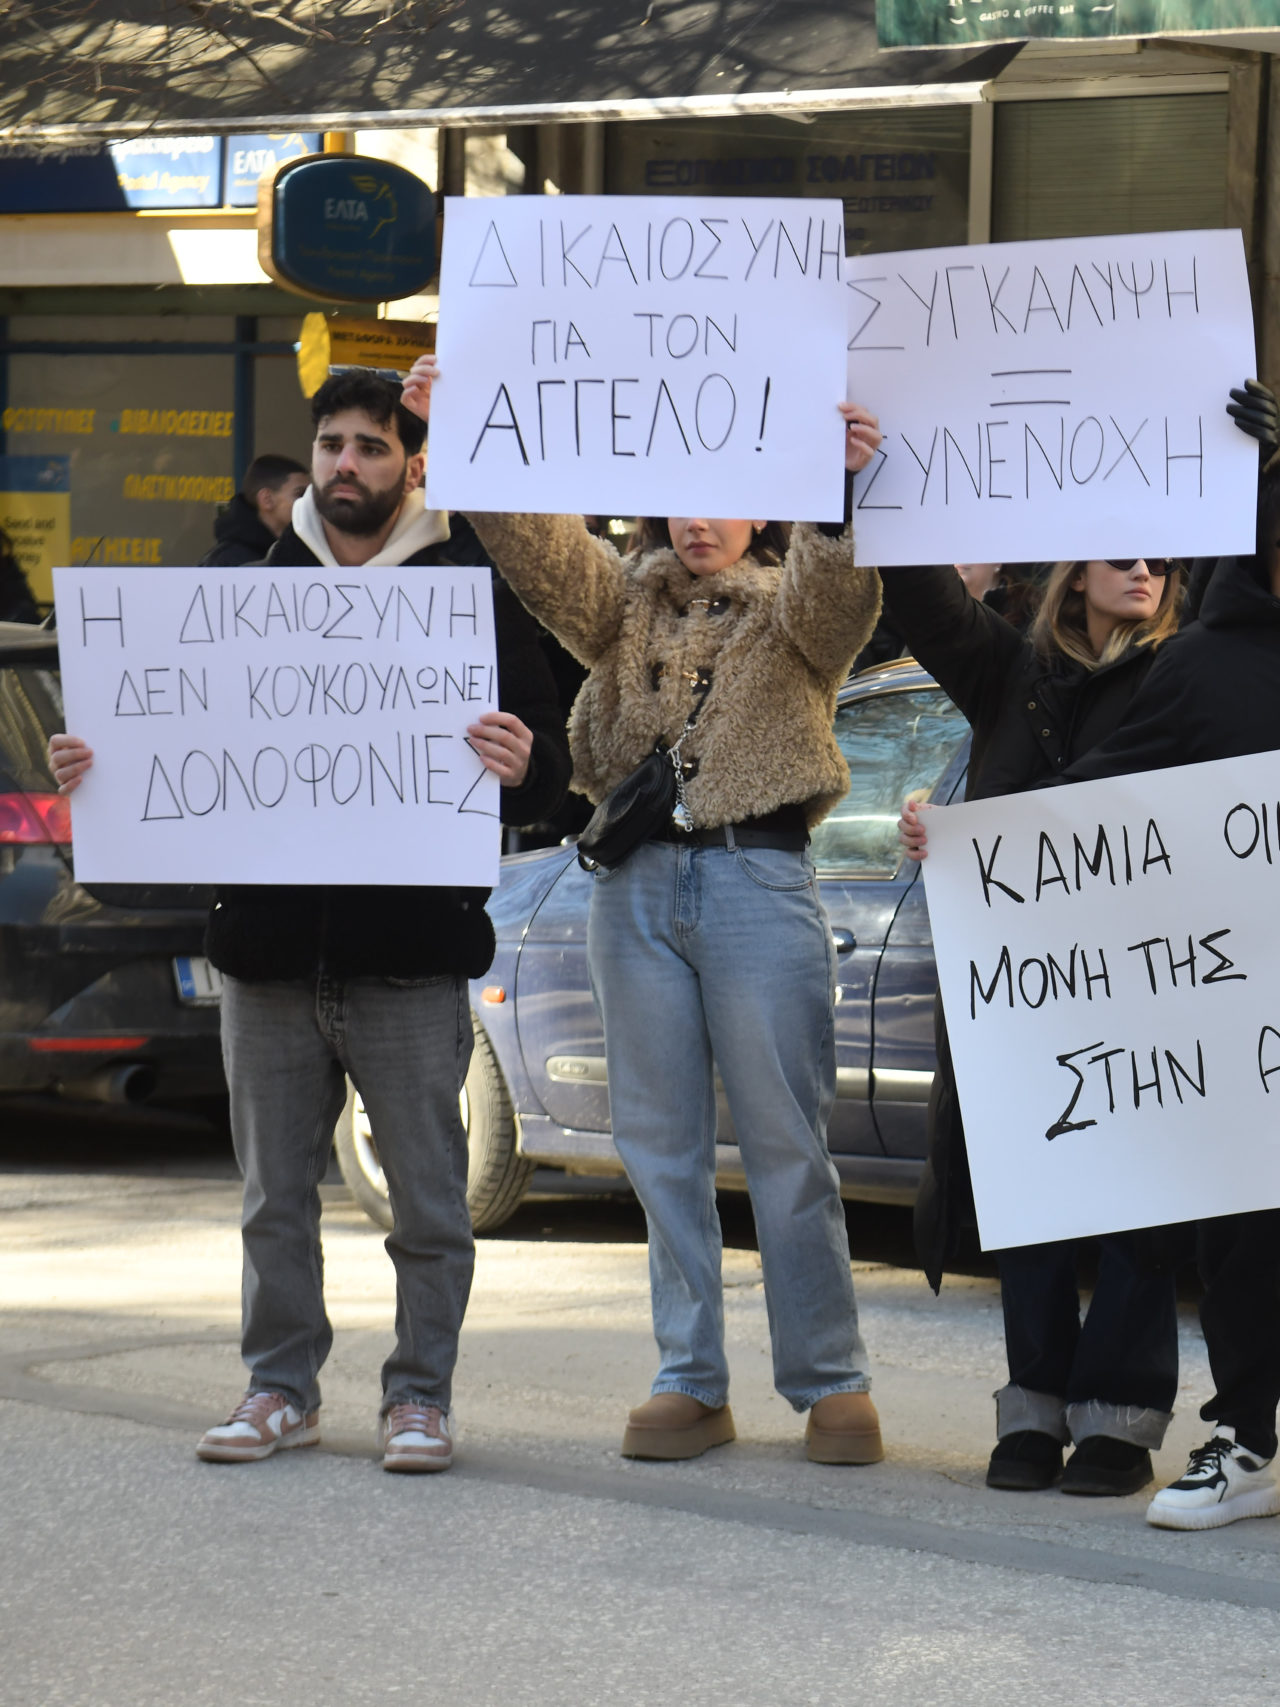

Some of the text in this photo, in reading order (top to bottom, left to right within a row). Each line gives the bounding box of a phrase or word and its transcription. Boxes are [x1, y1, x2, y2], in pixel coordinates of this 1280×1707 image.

[324, 198, 369, 220] ΕΛΤΑ
[469, 216, 842, 288] ΔΙΚΑΙΟΣΥΝΗ
[531, 312, 738, 365] ΓΙΑ ΤΟΝ
[846, 256, 1200, 352] ΣΥΓΚΑΛΥΨΗ
[469, 372, 771, 466] ΑΓΓΕΛΟ!
[857, 415, 1203, 510] ΣΥΝΕΝΟΧΗ
[35, 517, 56, 529] and
[80, 583, 478, 647] Η ΔΙΚΑΙΟΣΥΝΗ
[115, 662, 494, 720] ΔΕΝ ΚΟΥΚΟΥΛΩΝΕΙ
[140, 731, 500, 821] ΔΟΛΟΦΟΝΙΕΣ
[972, 818, 1172, 907] ΚΑΜΙΑ
[969, 942, 1112, 1020] ΜΟΝΗ
[1127, 929, 1247, 991] ΤΗΣ
[1045, 1040, 1207, 1141] ΣΤΗΝ
